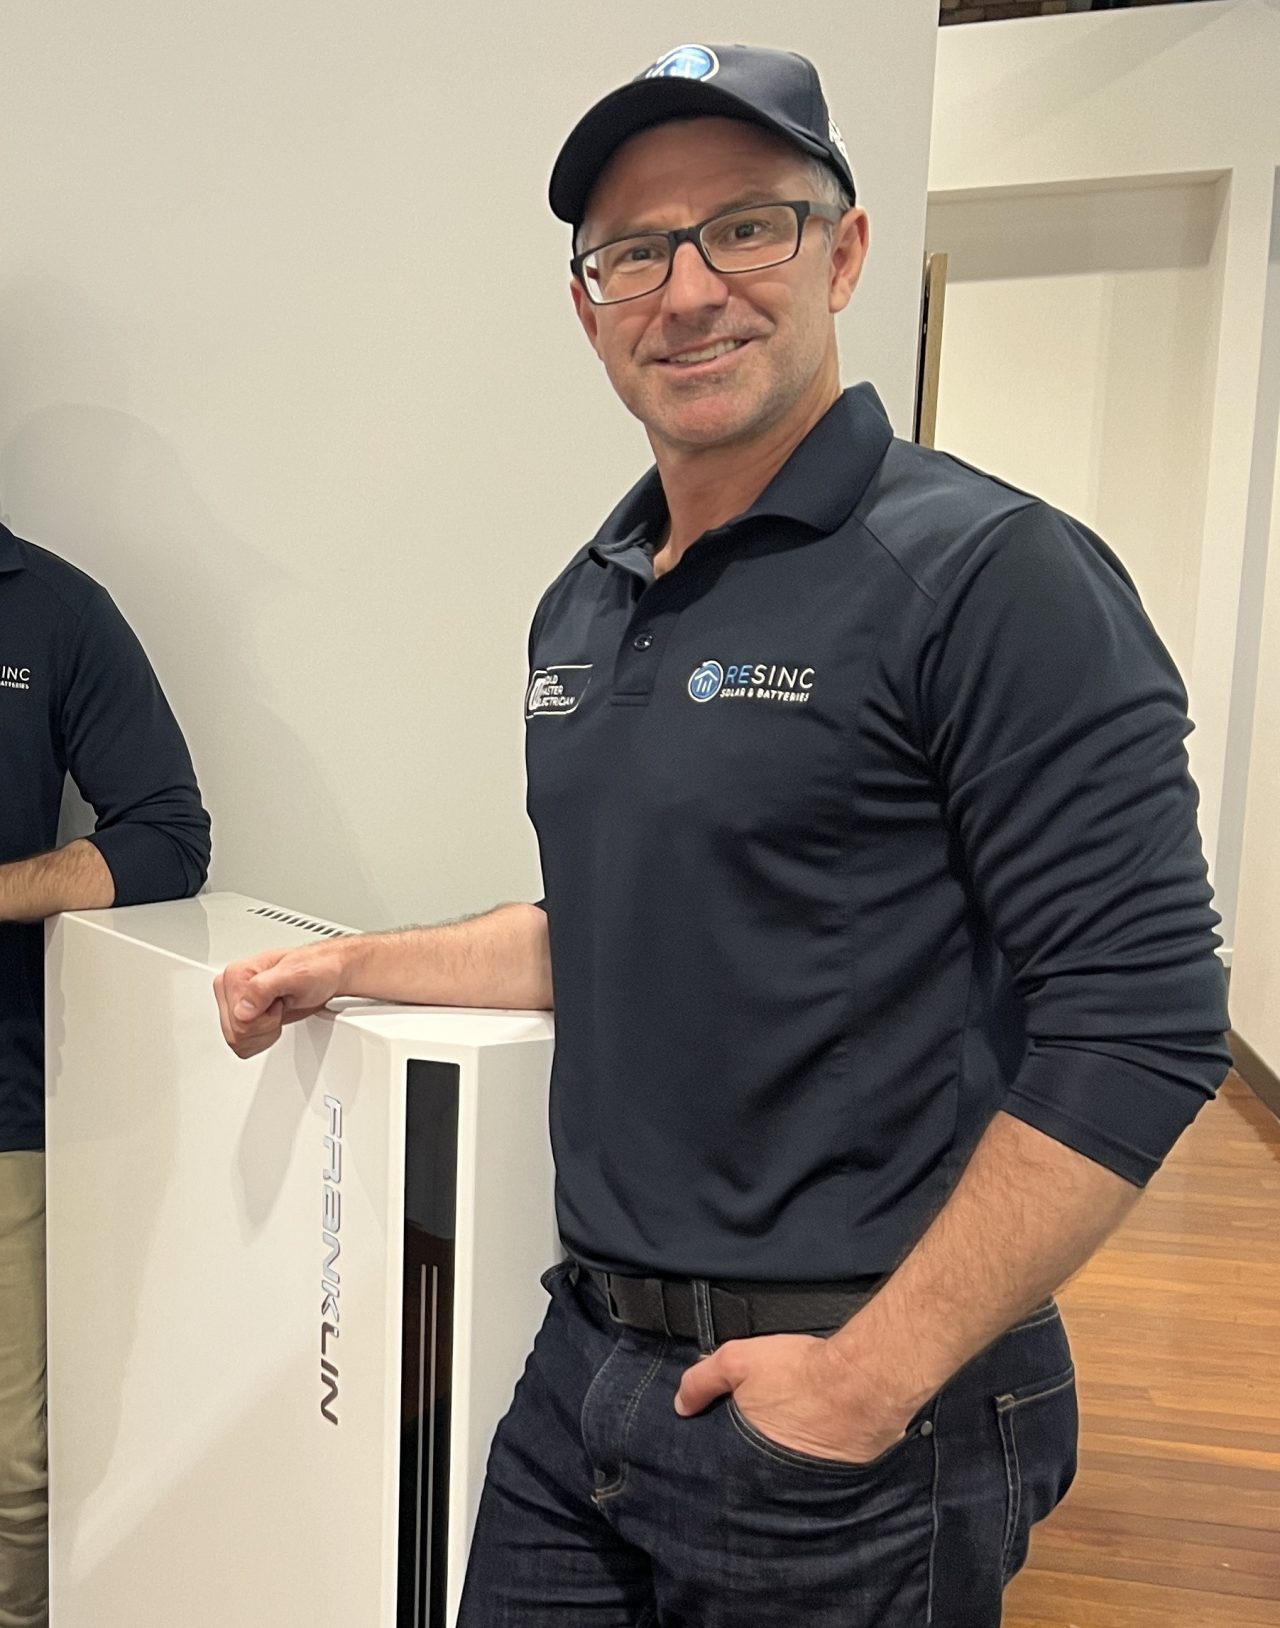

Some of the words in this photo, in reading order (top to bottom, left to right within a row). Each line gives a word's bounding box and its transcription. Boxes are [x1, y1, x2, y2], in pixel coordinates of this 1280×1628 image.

[544, 674, 559, 685] OLD
[724, 664, 815, 689] RESINC
[542, 684, 564, 695] ASTER
[720, 687, 746, 698] SOLAR
[756, 688, 810, 702] BATTERIES
[321, 1095, 343, 1425] FRANKLIN
